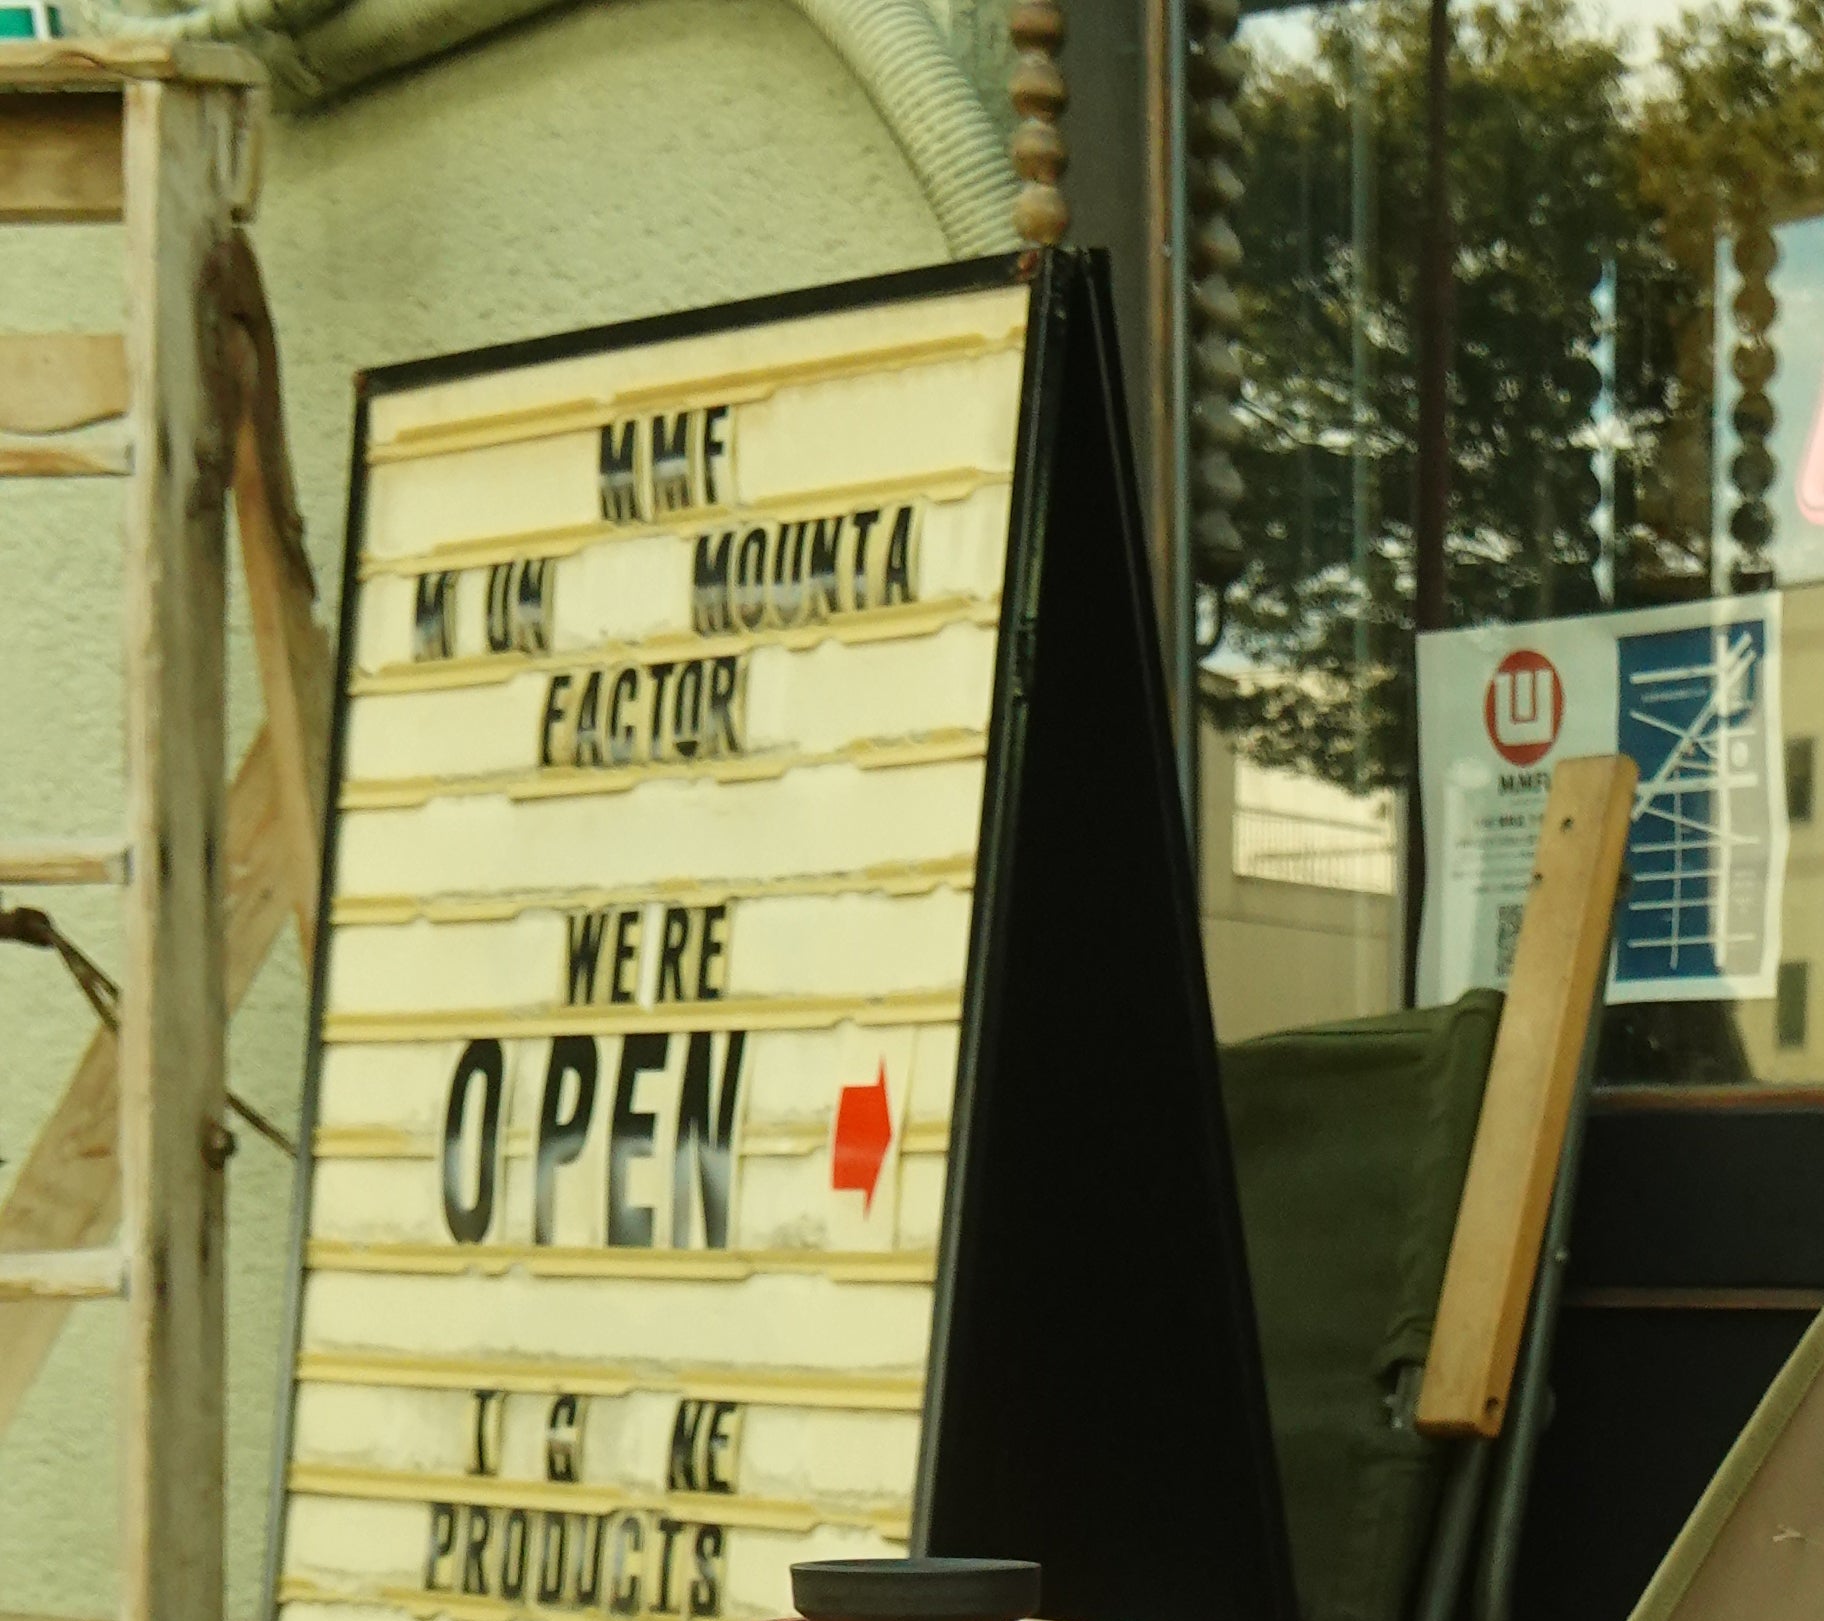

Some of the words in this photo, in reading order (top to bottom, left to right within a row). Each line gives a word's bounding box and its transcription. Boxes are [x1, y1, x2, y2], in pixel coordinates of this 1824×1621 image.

[539, 656, 744, 767] FACTOR
[442, 1031, 747, 1249] OPEN
[424, 1503, 723, 1618] PRODUCTS
